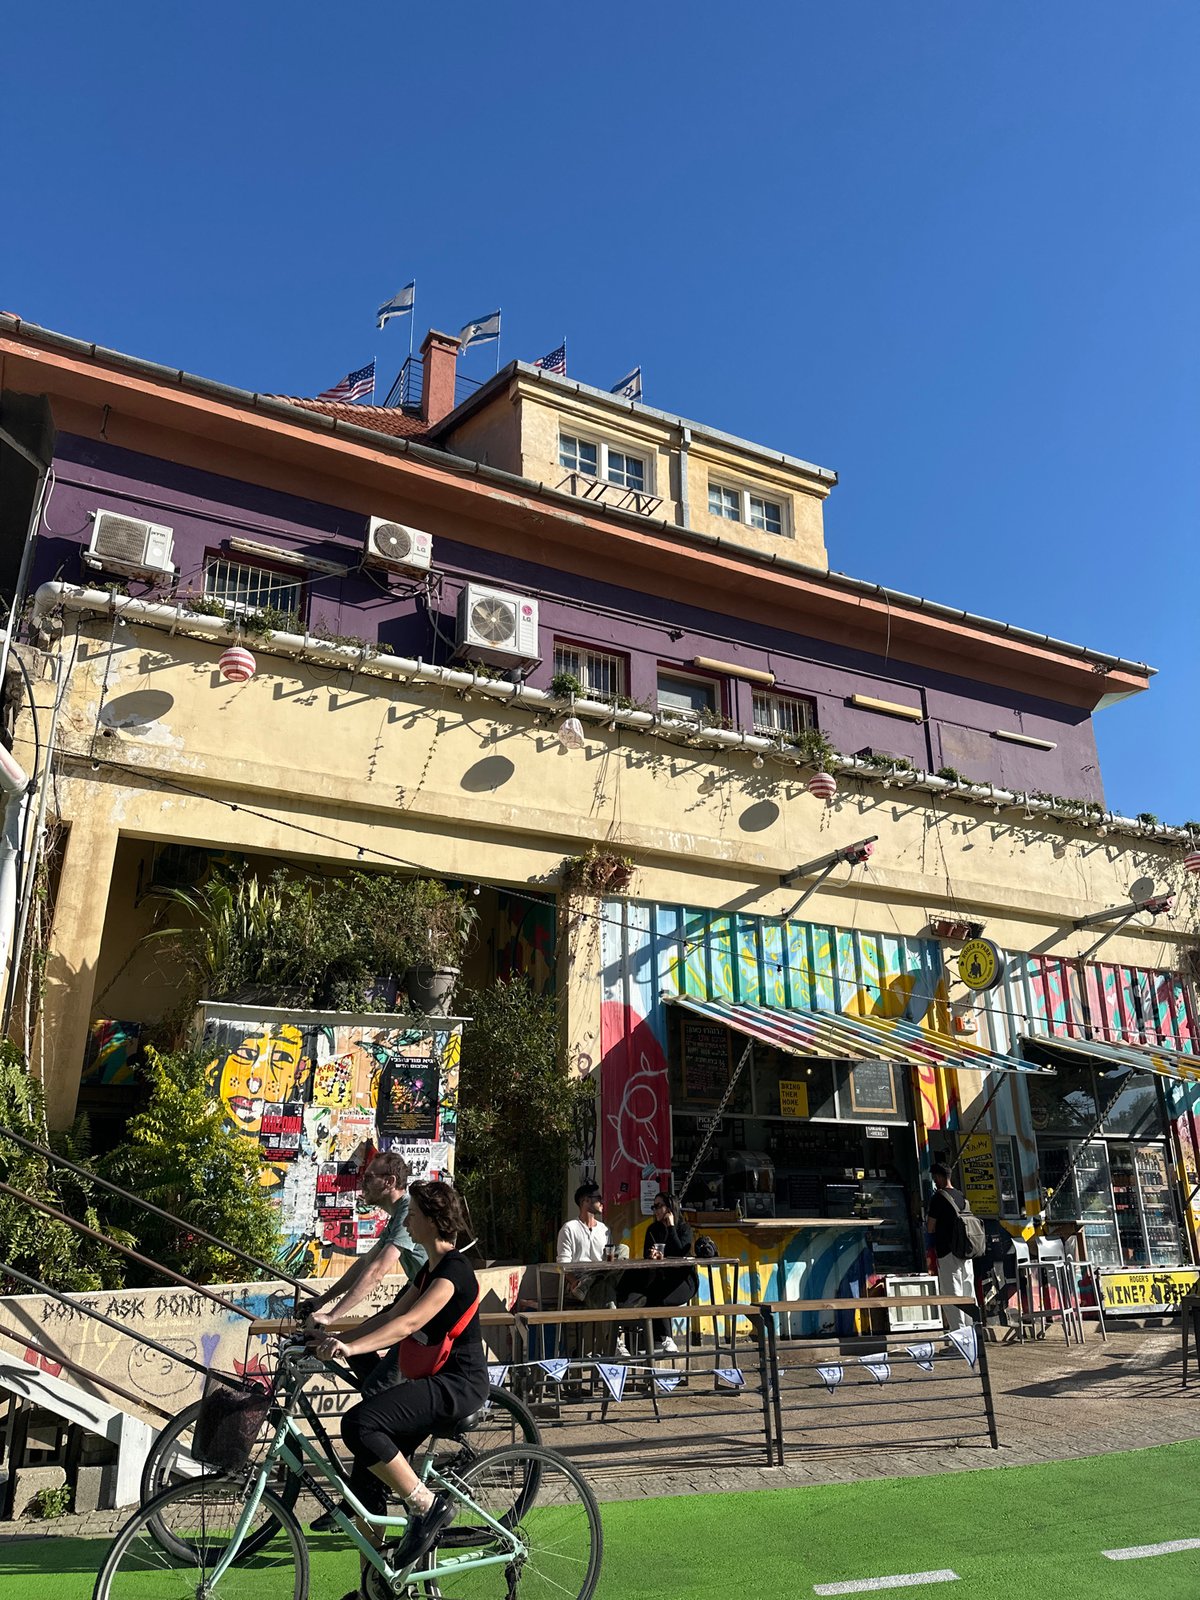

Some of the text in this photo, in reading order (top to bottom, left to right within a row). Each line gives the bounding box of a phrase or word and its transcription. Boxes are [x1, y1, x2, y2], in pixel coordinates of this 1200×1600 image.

[522, 615, 532, 623] LG
[782, 1090, 798, 1098] THEM
[782, 1098, 799, 1106] HOME
[1129, 1275, 1149, 1283] ROGER'S
[1106, 1285, 1146, 1305] WINE?
[105, 1296, 147, 1320] ASK
[305, 1476, 333, 1511] EVOKE
